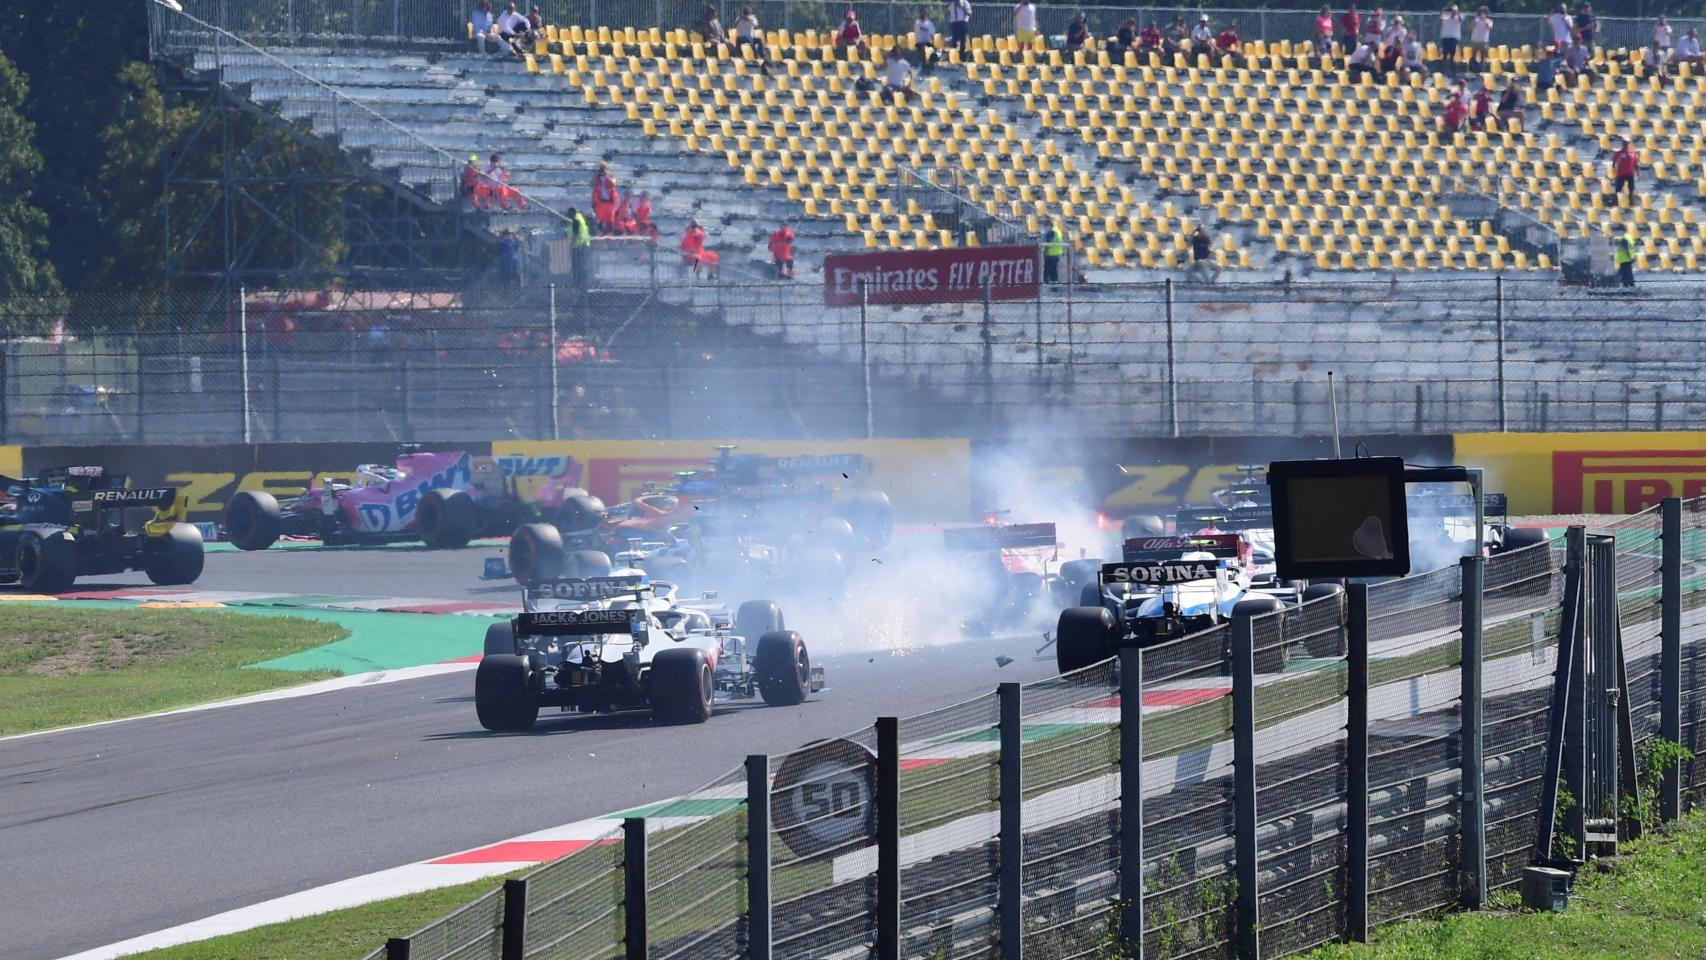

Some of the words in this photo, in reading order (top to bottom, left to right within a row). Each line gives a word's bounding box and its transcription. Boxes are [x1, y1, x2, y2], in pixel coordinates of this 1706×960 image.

[834, 266, 938, 295] Emirates
[949, 262, 974, 289] FLY
[94, 489, 168, 502] RENAULT
[395, 452, 473, 521] BWT
[1143, 538, 1175, 552] Alfa
[1114, 564, 1213, 582] SOFINA
[539, 580, 630, 599] SOFINA
[580, 610, 628, 623] JONES
[802, 781, 862, 820] 50
